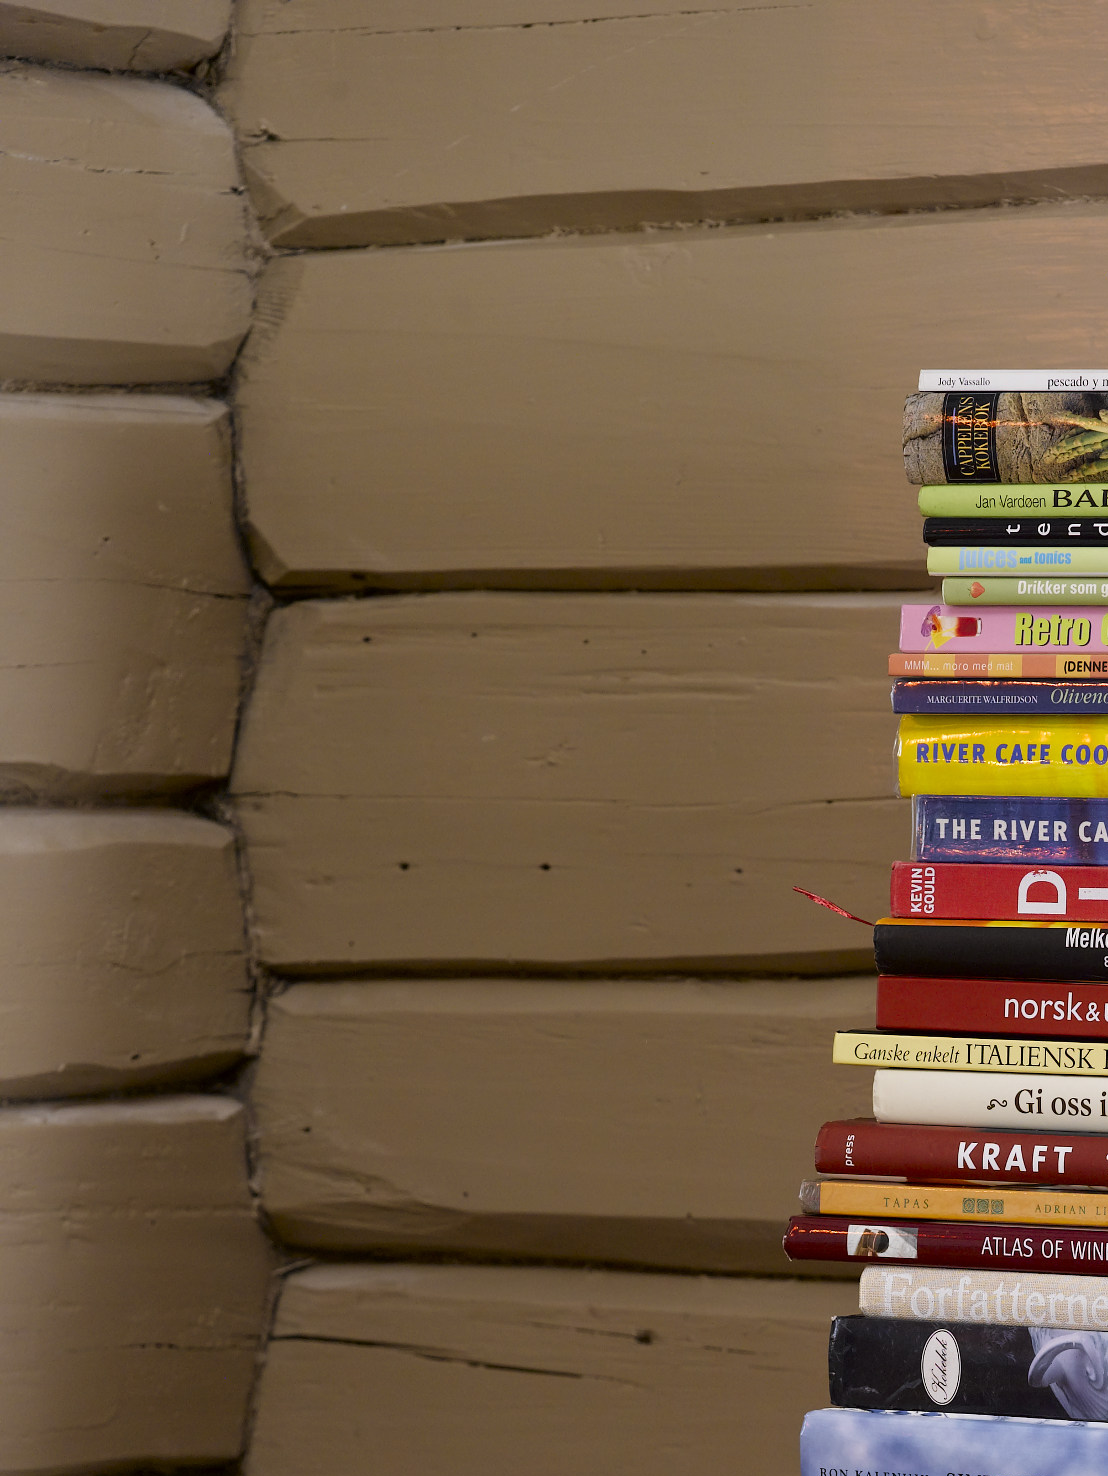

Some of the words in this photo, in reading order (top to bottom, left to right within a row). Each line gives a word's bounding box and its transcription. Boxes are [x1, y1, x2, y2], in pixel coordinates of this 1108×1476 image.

[937, 377, 956, 389] Jody
[958, 377, 991, 387] Vassallo
[1047, 375, 1090, 390] pescado
[1092, 378, 1099, 390] y
[957, 396, 975, 476] CAPPELENS
[974, 401, 991, 470] KOKEBOK
[975, 494, 996, 509] Jan
[998, 494, 1047, 509] Vardøen
[958, 546, 1018, 571] juices
[1019, 555, 1032, 565] and
[1034, 550, 1072, 565] tonics
[1017, 579, 1067, 595] Drikker
[1069, 583, 1097, 595] som
[1013, 612, 1093, 648] Retro
[903, 660, 940, 671] MMM...
[942, 661, 970, 671] moro
[972, 660, 994, 671] med
[996, 661, 1014, 671] mat
[1063, 660, 1108, 675] (DENNE
[926, 694, 983, 704] MARGUERITE
[983, 694, 1038, 705] WALFRIDSON
[915, 742, 986, 764] RIVER
[995, 743, 1051, 765] CAFE
[935, 818, 982, 840] THE
[993, 819, 1068, 842] RIVER
[910, 867, 923, 914] KEVIN
[923, 866, 936, 914] GOULD
[853, 1041, 911, 1063] Ganske
[915, 1045, 960, 1065] enkelt
[965, 1043, 1096, 1071] ITALIENSK
[1013, 1088, 1043, 1115] Gi
[1050, 1096, 1093, 1118] oss
[1100, 1091, 1108, 1117] i
[845, 1133, 855, 1167] press
[956, 1141, 1074, 1174] KRAFT
[883, 1196, 930, 1209] TAPAS
[1034, 1203, 1087, 1216] ADRIAN
[980, 1236, 1034, 1259] ATLAS
[1041, 1238, 1064, 1259] OF
[931, 1338, 949, 1401] Kokebok
